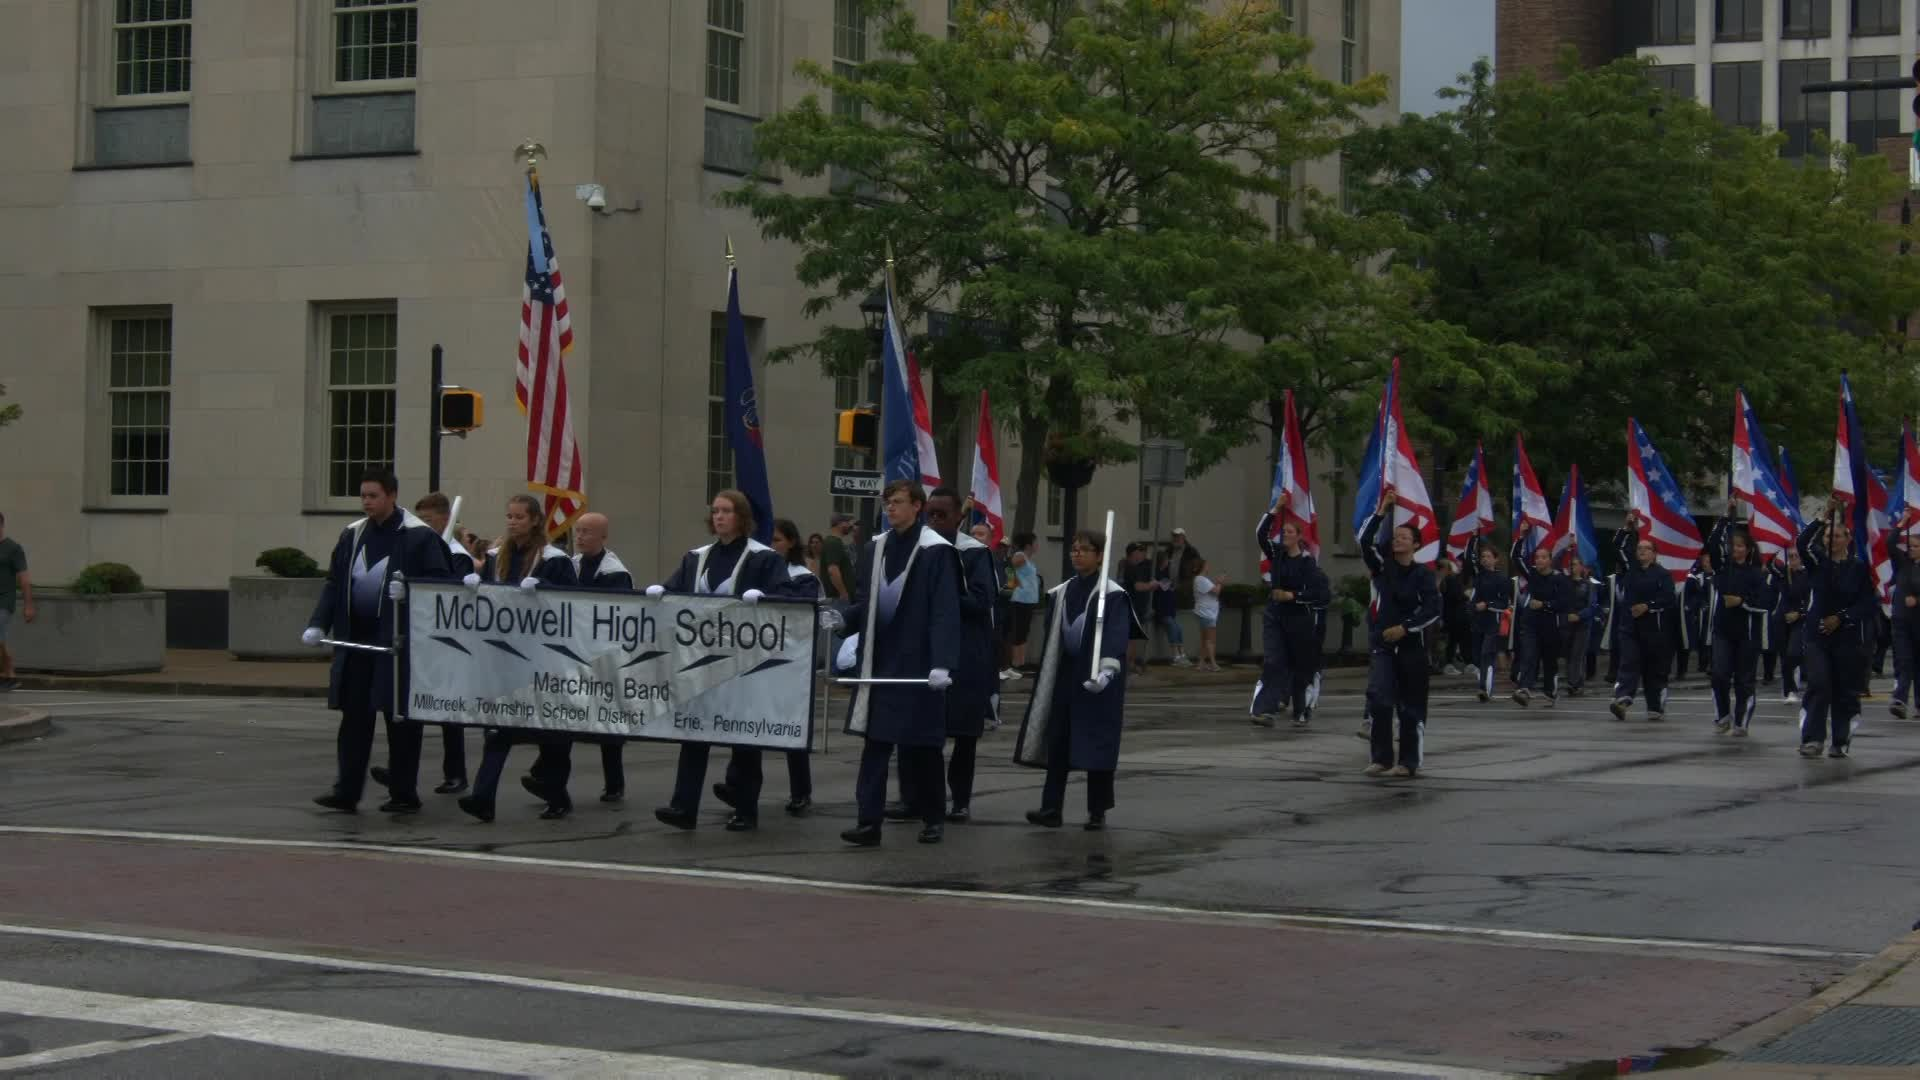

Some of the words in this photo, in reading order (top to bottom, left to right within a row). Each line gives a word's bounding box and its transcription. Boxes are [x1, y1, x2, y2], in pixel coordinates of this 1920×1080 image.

[860, 479, 879, 489] WAY
[435, 593, 573, 638] McDowell
[593, 605, 656, 652] High
[675, 609, 786, 652] School
[533, 671, 614, 703] Marching
[624, 678, 670, 701] Band
[413, 693, 467, 713] Millcreek
[476, 697, 535, 719] Township
[542, 701, 590, 720] School
[597, 706, 645, 726] District
[713, 714, 801, 738] Pennsylvania
